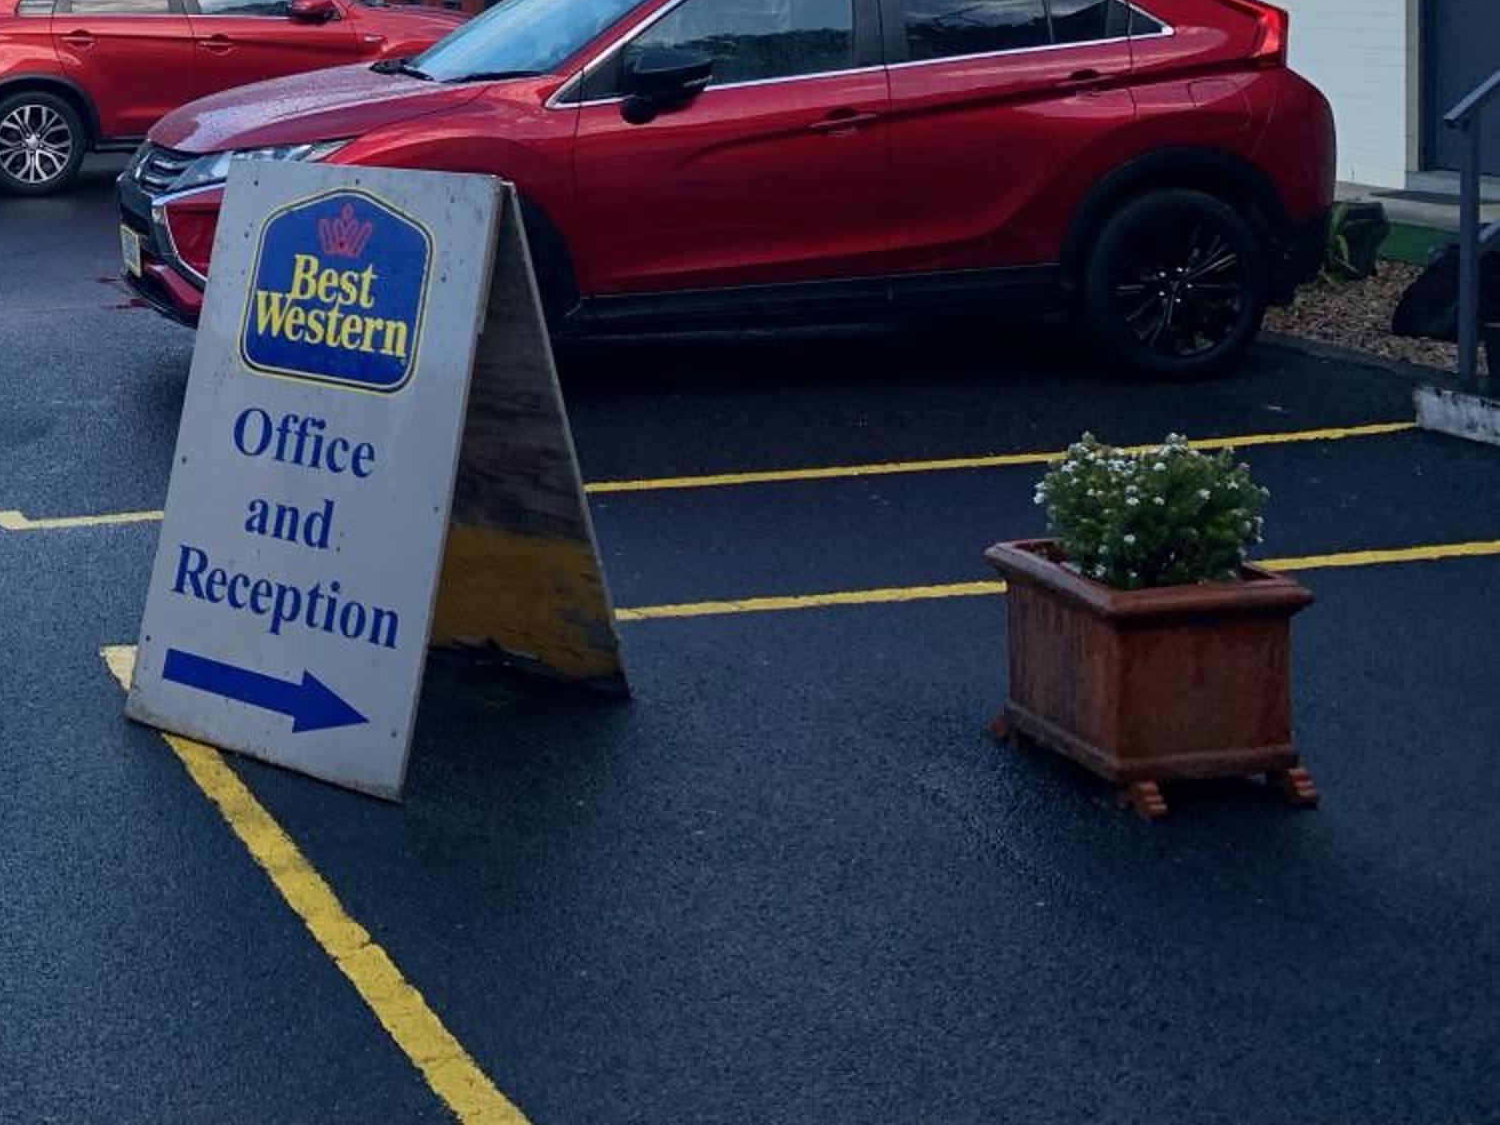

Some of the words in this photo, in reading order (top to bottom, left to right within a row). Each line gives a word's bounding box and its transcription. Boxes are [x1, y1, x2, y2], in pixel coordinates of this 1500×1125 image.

[291, 253, 378, 309] Best
[256, 290, 408, 358] Western
[233, 407, 376, 478] Office
[244, 498, 336, 550] and
[170, 544, 400, 650] Reception
